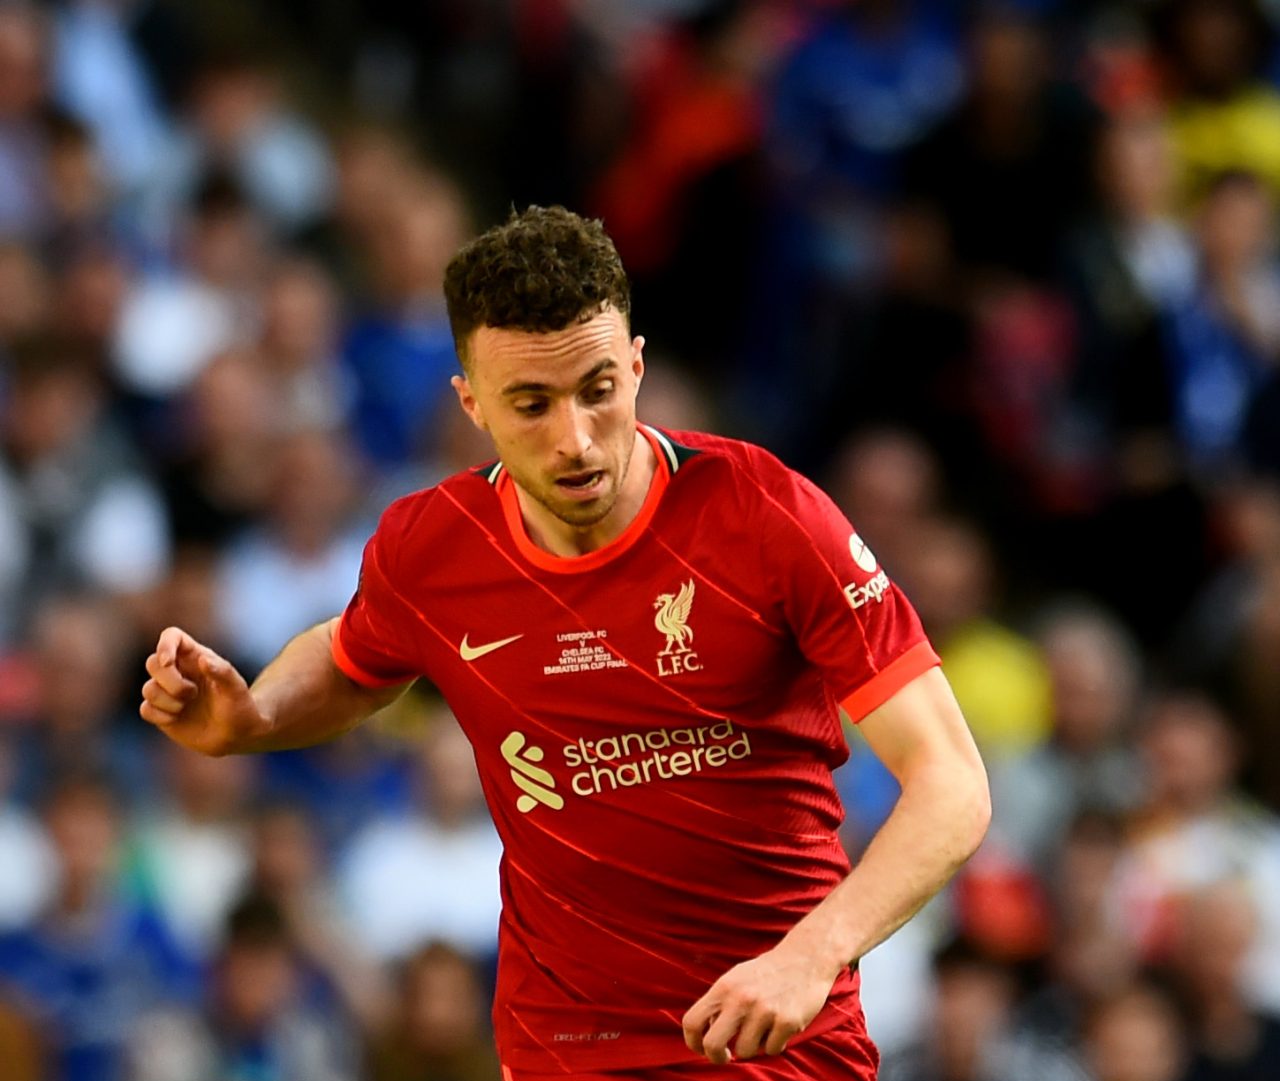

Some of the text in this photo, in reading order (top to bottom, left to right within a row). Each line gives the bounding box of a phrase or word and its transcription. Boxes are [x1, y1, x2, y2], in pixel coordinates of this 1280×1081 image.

[557, 630, 607, 642] LIVERPOOL FC
[562, 646, 604, 657] CHELSEA FC
[558, 656, 577, 664] 14TH
[577, 655, 593, 663] MAY
[543, 659, 628, 675] EMIRATES FA CUP FINAL
[563, 718, 734, 767] standard
[571, 732, 752, 796] chartered
